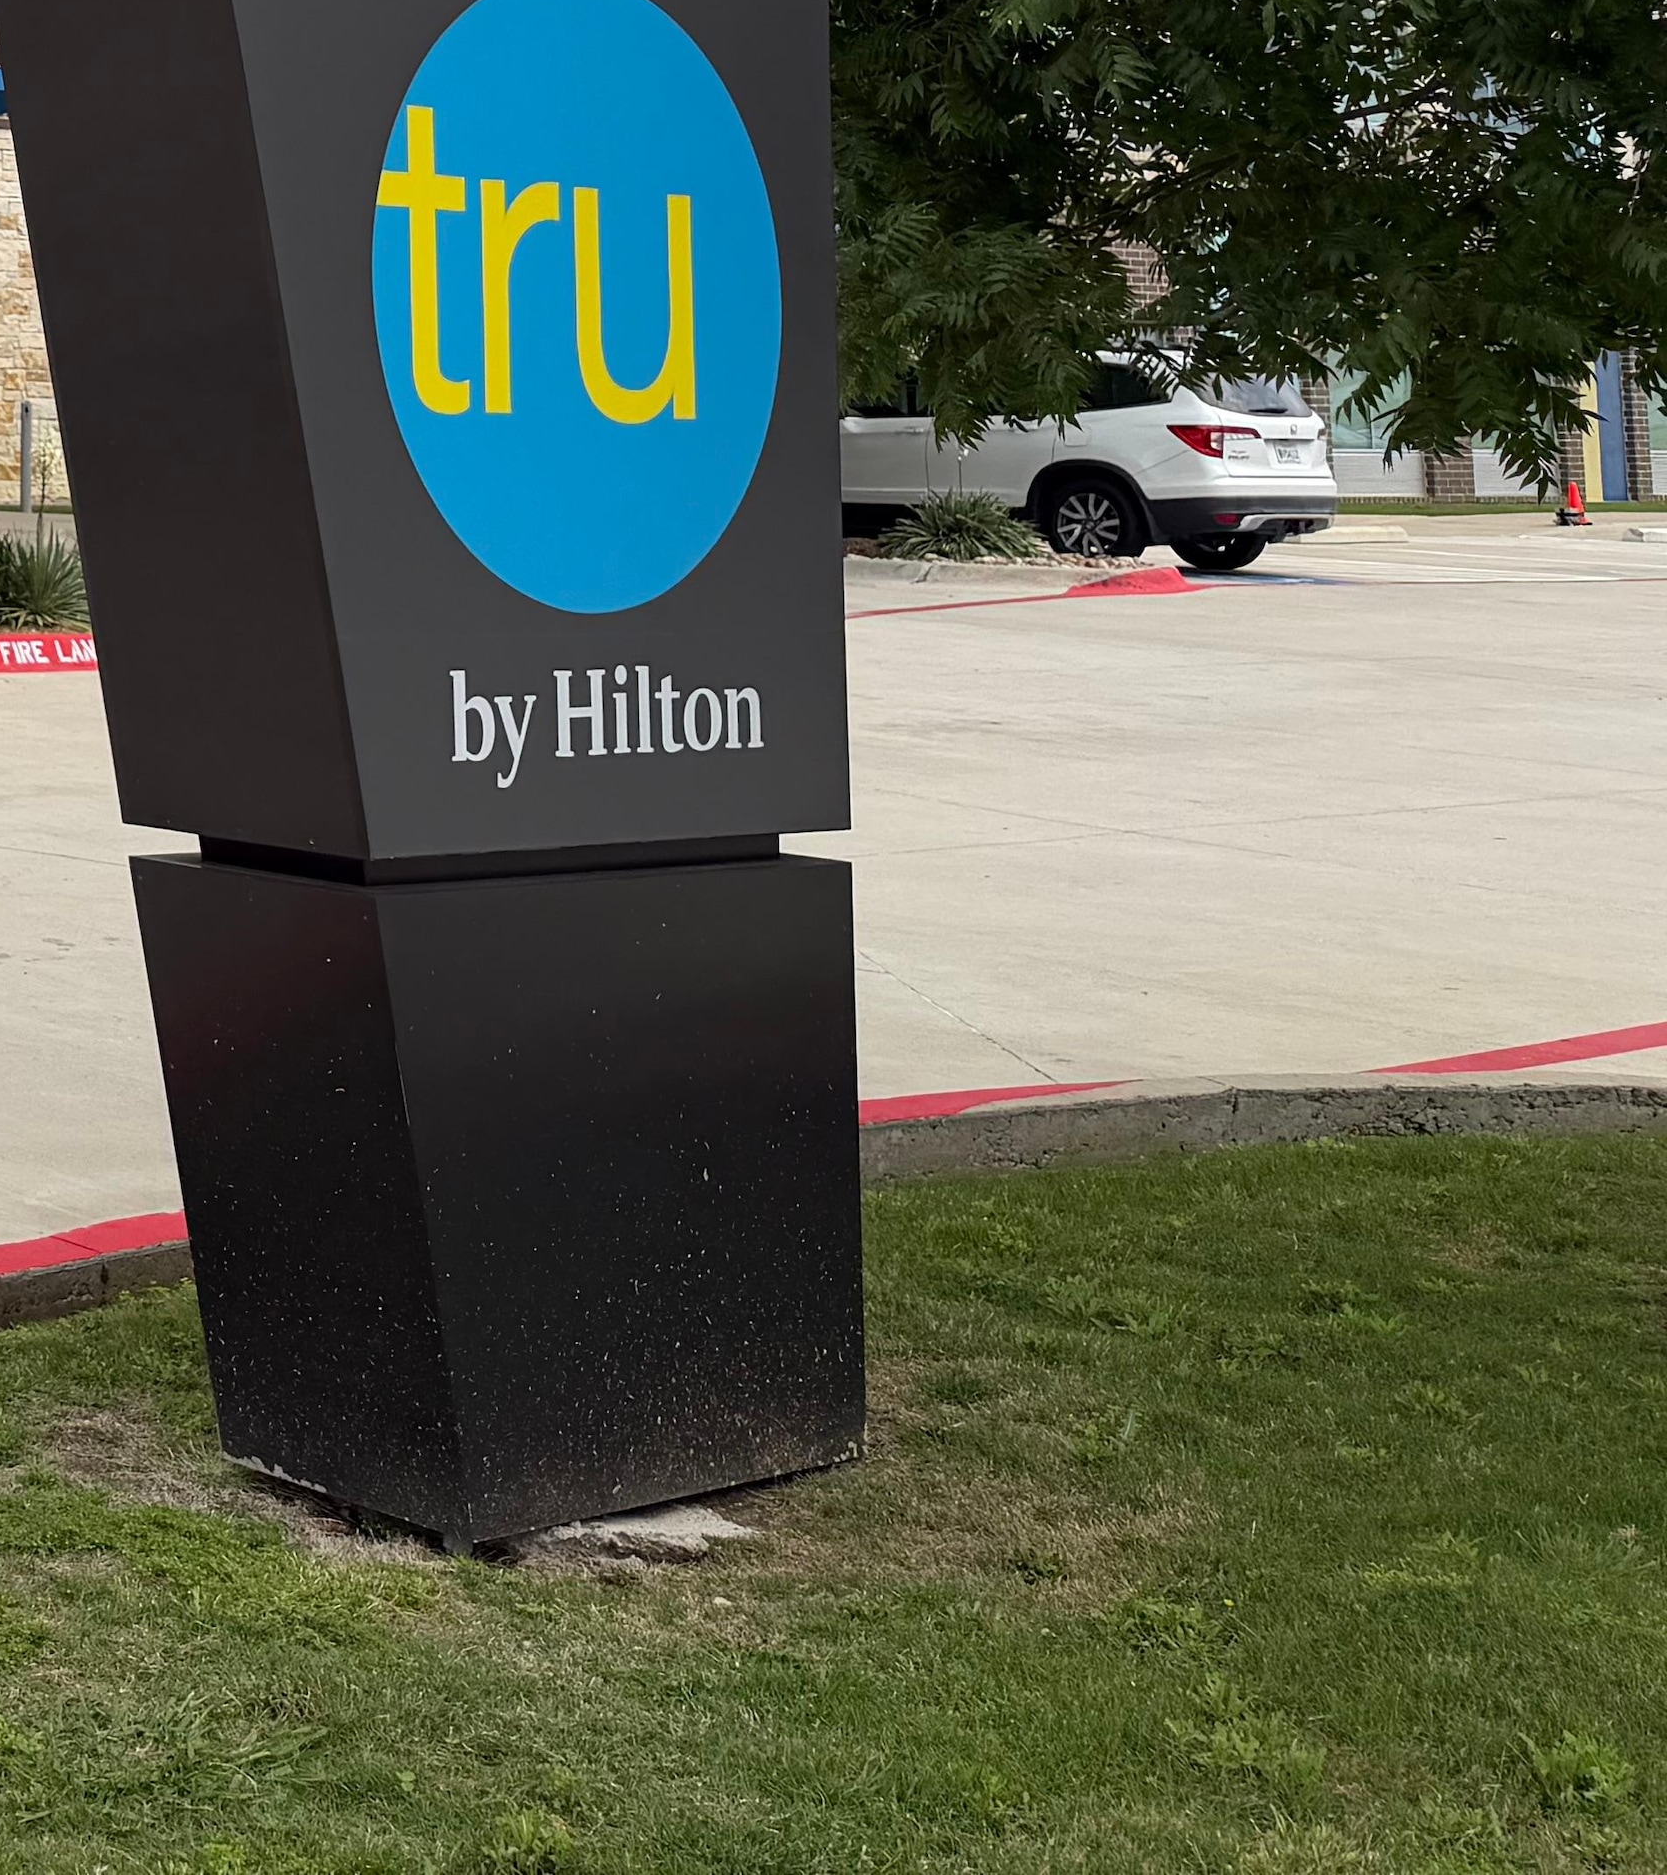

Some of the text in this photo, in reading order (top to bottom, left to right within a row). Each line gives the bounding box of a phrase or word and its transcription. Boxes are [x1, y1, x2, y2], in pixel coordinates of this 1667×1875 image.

[375, 104, 696, 424] tru
[53, 639, 98, 663] LAN
[449, 664, 765, 789] by Hilton
